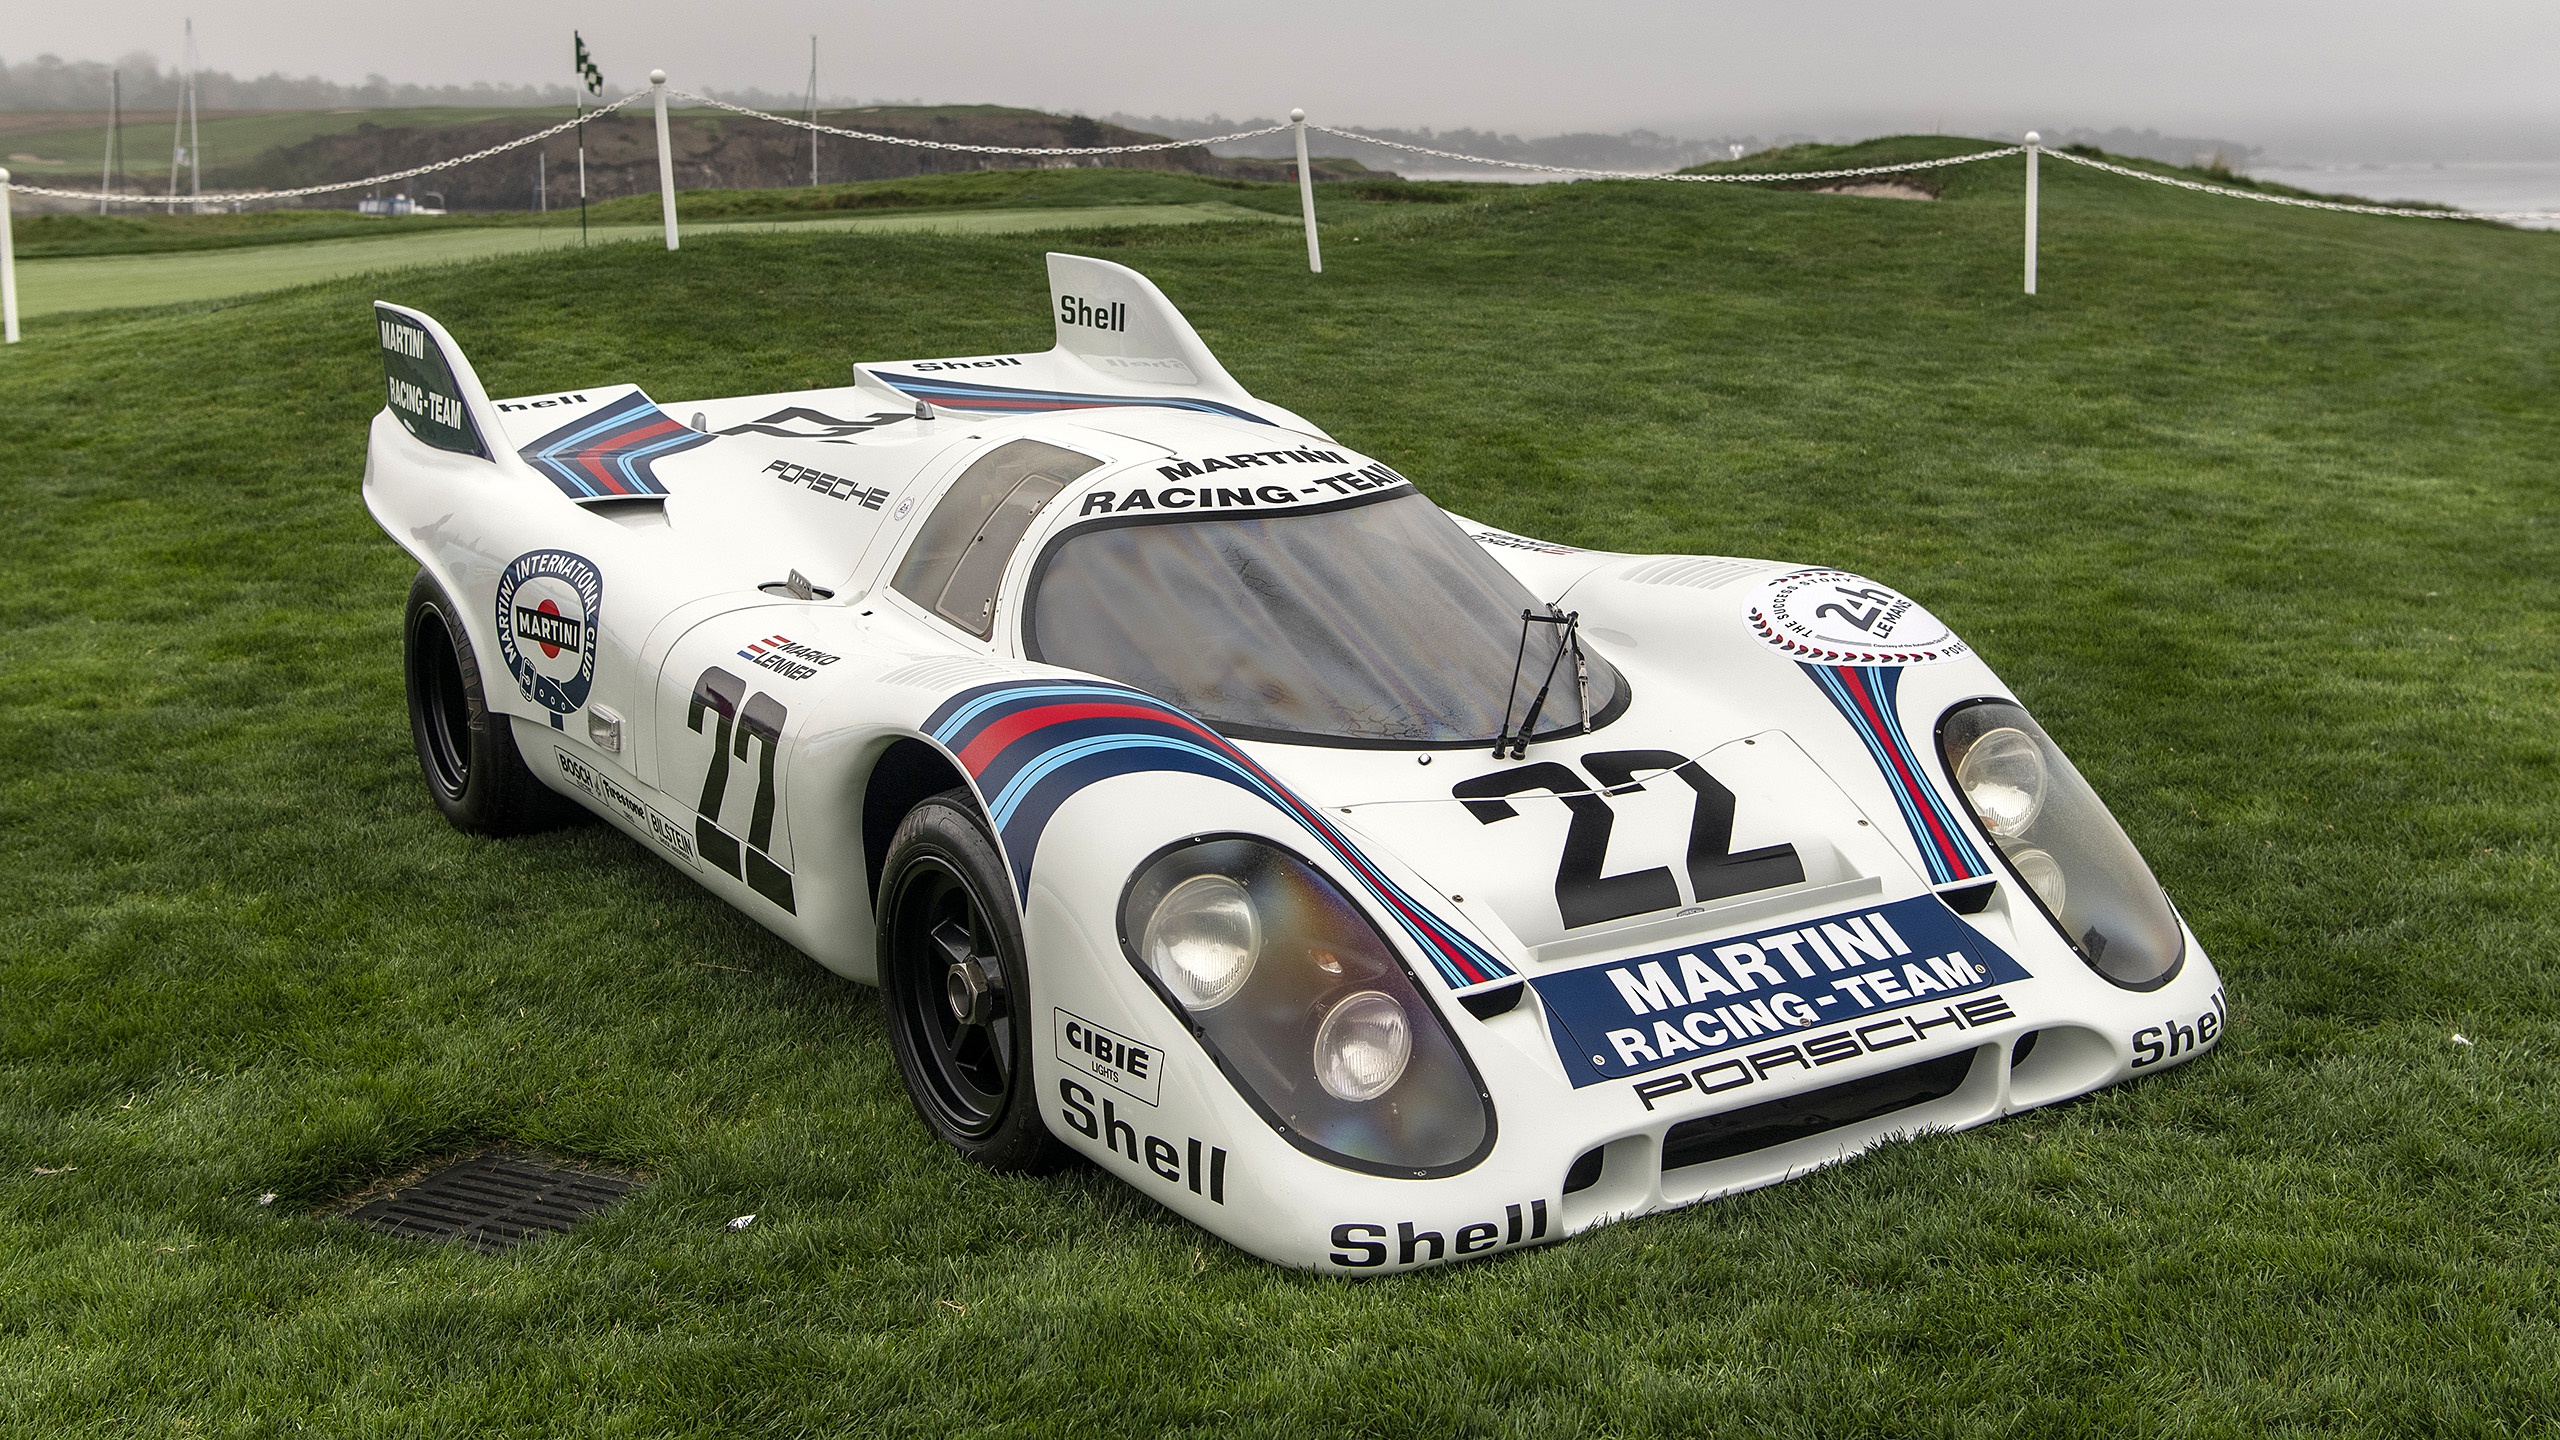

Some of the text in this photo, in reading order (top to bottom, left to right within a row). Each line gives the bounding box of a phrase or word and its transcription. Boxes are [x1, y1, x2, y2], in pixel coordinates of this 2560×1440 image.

[1061, 295, 1125, 333] Shell
[381, 320, 424, 360] MARTINI
[912, 357, 1022, 372] Shell
[389, 376, 462, 430] RACING-TEAM
[497, 394, 588, 413] hell
[761, 459, 891, 511] PORSCHE
[1156, 449, 1350, 482] MARTINI
[1079, 463, 1404, 517] RACING-TEAM
[499, 554, 598, 682] MARTINI INTERNATIONAL CLUB
[1772, 585, 1798, 621] SUCCESS
[1815, 586, 1895, 632] 24h
[518, 611, 578, 647] MARTINI
[1784, 620, 1813, 638] THE
[752, 651, 817, 681] LENNEP
[777, 642, 841, 666] MARKO
[559, 753, 594, 789] BOSCH
[687, 666, 797, 917] 22
[603, 779, 646, 820] Firestone
[650, 812, 694, 858] BILSTEIN
[1452, 749, 1806, 931] 22
[1605, 912, 1913, 1016] MARTINI
[1605, 950, 1983, 1067] RACING-TEAM
[2131, 986, 2228, 1068] Shell
[1092, 1060, 1119, 1083] LIGHTS
[1632, 995, 2017, 1111] PORSCHE
[1059, 1078, 1227, 1205] Shell
[1330, 1199, 1548, 1267] Shell
